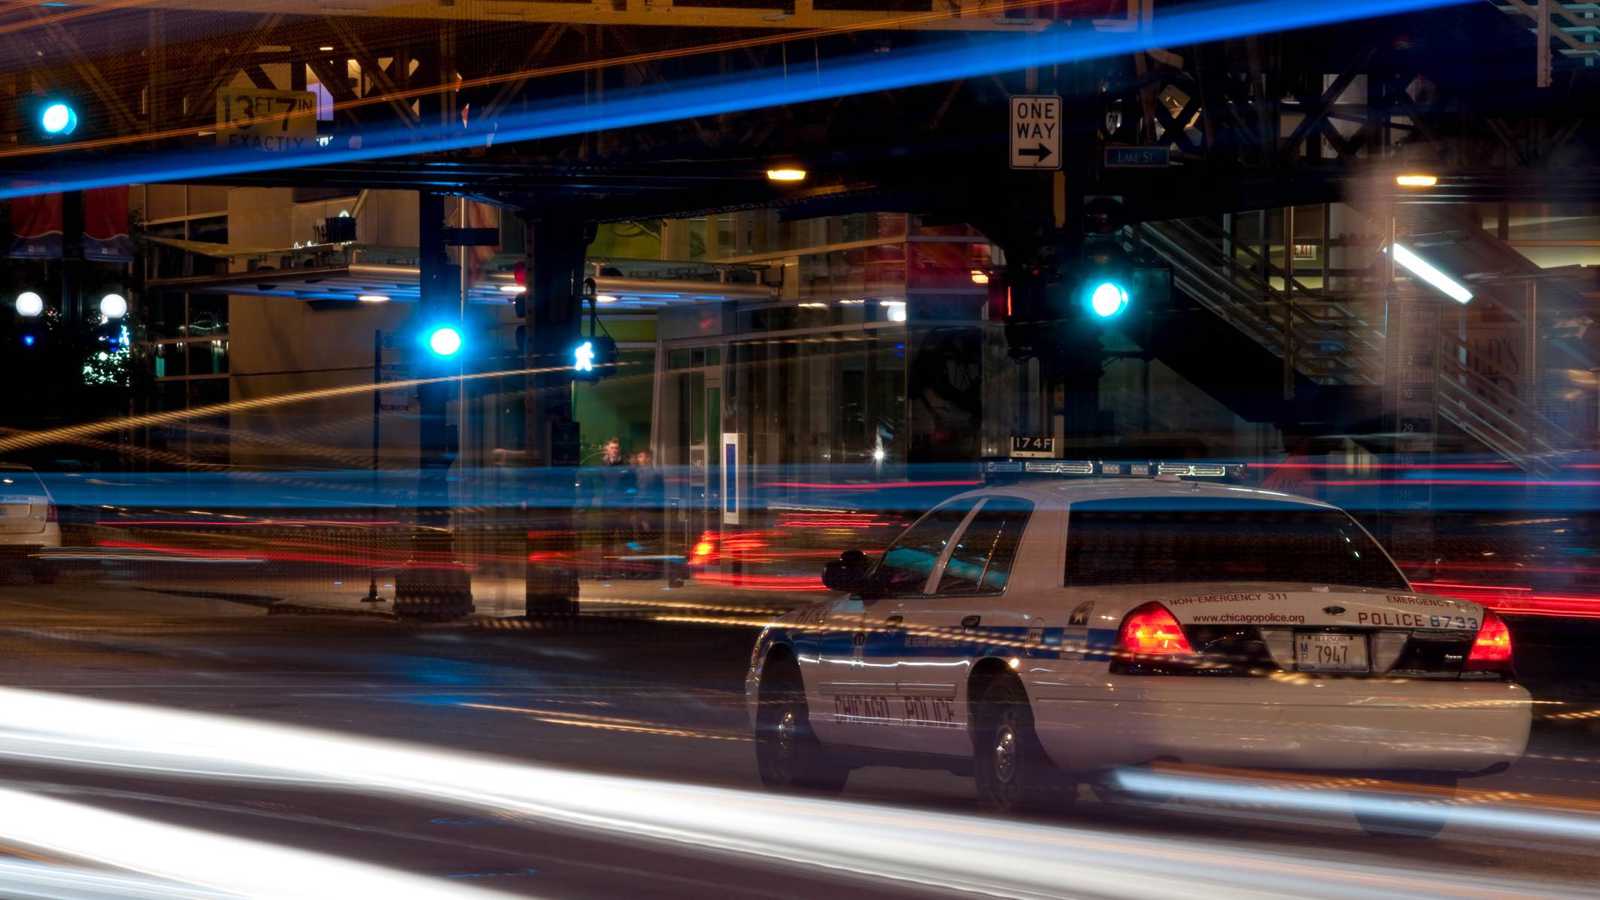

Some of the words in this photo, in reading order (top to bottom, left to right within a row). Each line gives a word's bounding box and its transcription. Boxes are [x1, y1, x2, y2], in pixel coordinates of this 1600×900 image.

[224, 95, 255, 130] 13
[255, 97, 272, 113] FT
[275, 97, 296, 131] 7
[297, 98, 313, 113] IN
[1017, 102, 1055, 119] ONE
[1016, 123, 1055, 139] WAY
[1169, 592, 1262, 606] NON-EMERGENCY
[1267, 592, 1288, 601] 311
[1192, 613, 1305, 624] www.chicagopolice.org
[1357, 611, 1425, 628] POLICE
[1315, 645, 1349, 665] 7947
[834, 695, 890, 723] CHICAGO
[903, 696, 955, 727] POLICE
